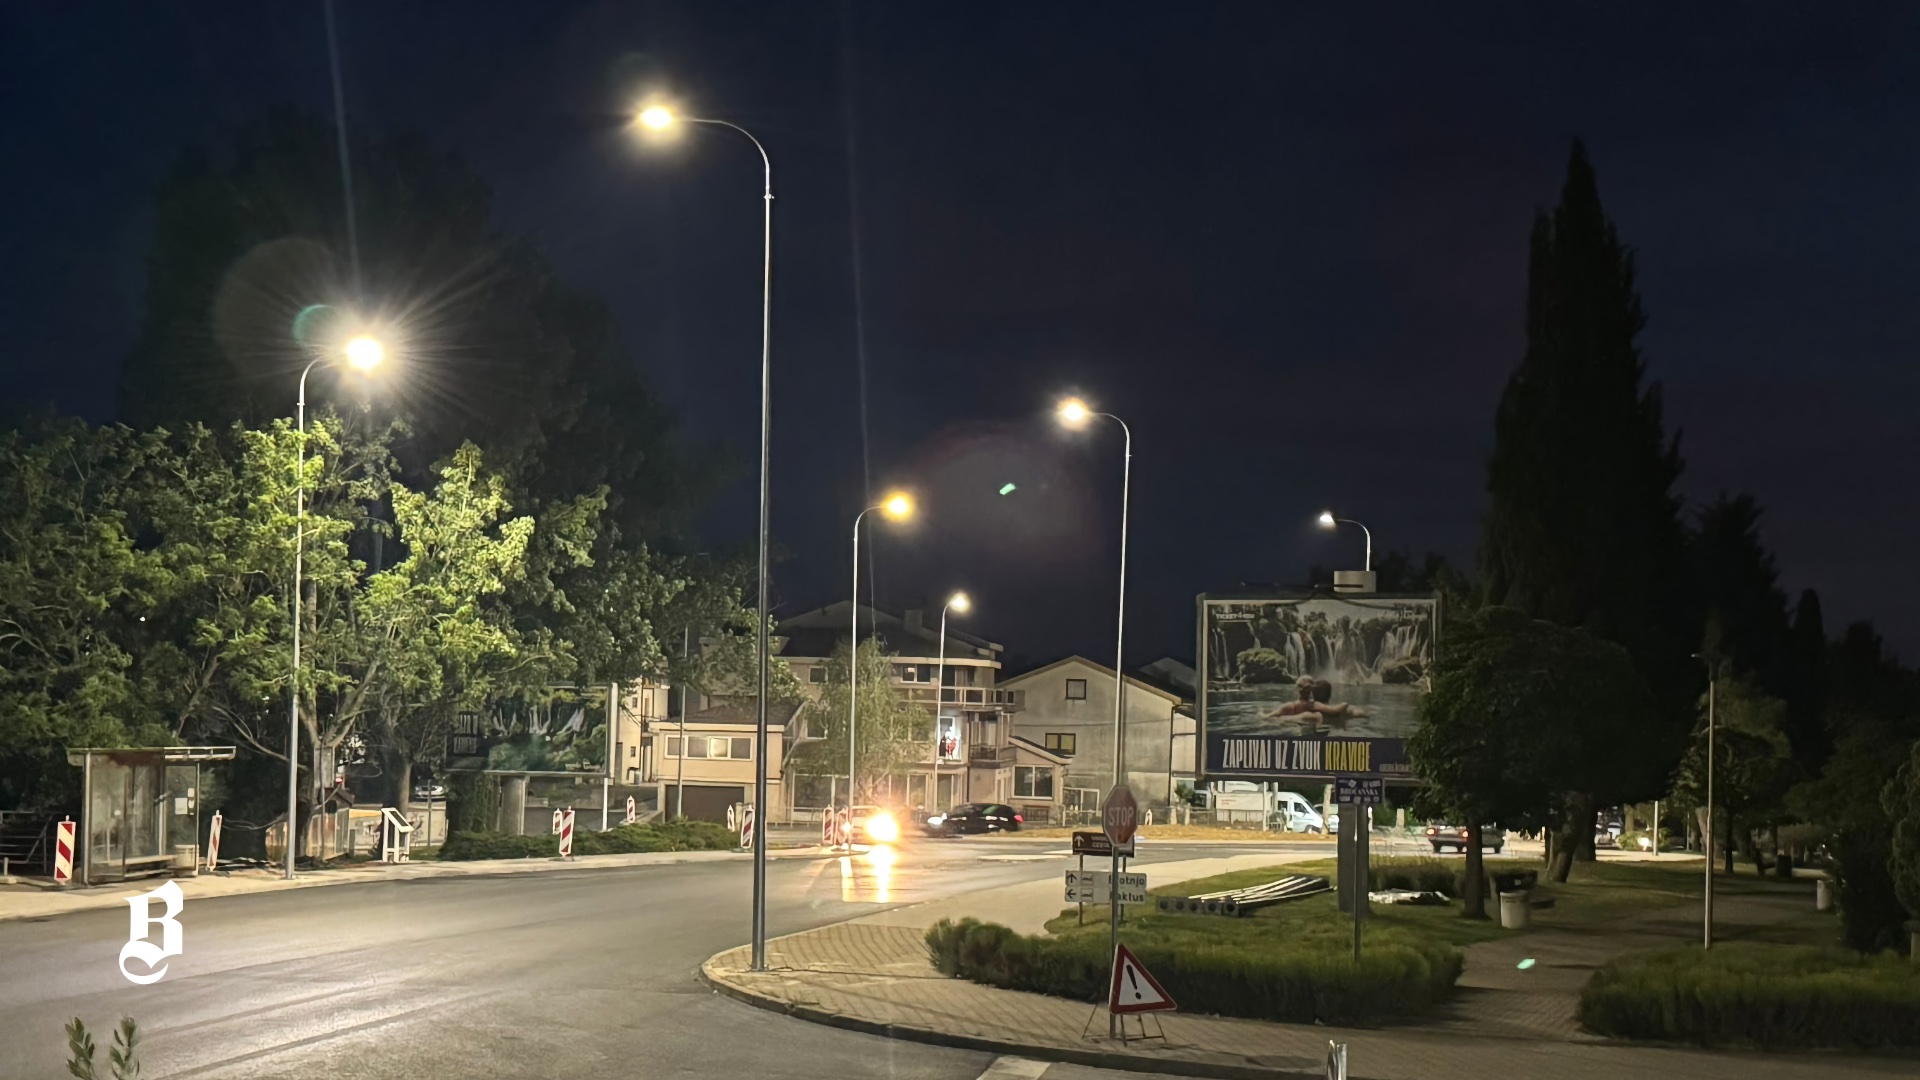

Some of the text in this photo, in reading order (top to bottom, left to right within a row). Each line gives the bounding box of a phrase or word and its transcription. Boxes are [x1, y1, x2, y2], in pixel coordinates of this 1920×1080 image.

[1222, 739, 1372, 772] ZAPLIVAJ UZ ZVUK KRAVICE
[1108, 806, 1134, 826] STOP
[1109, 875, 1145, 887] otnjo
